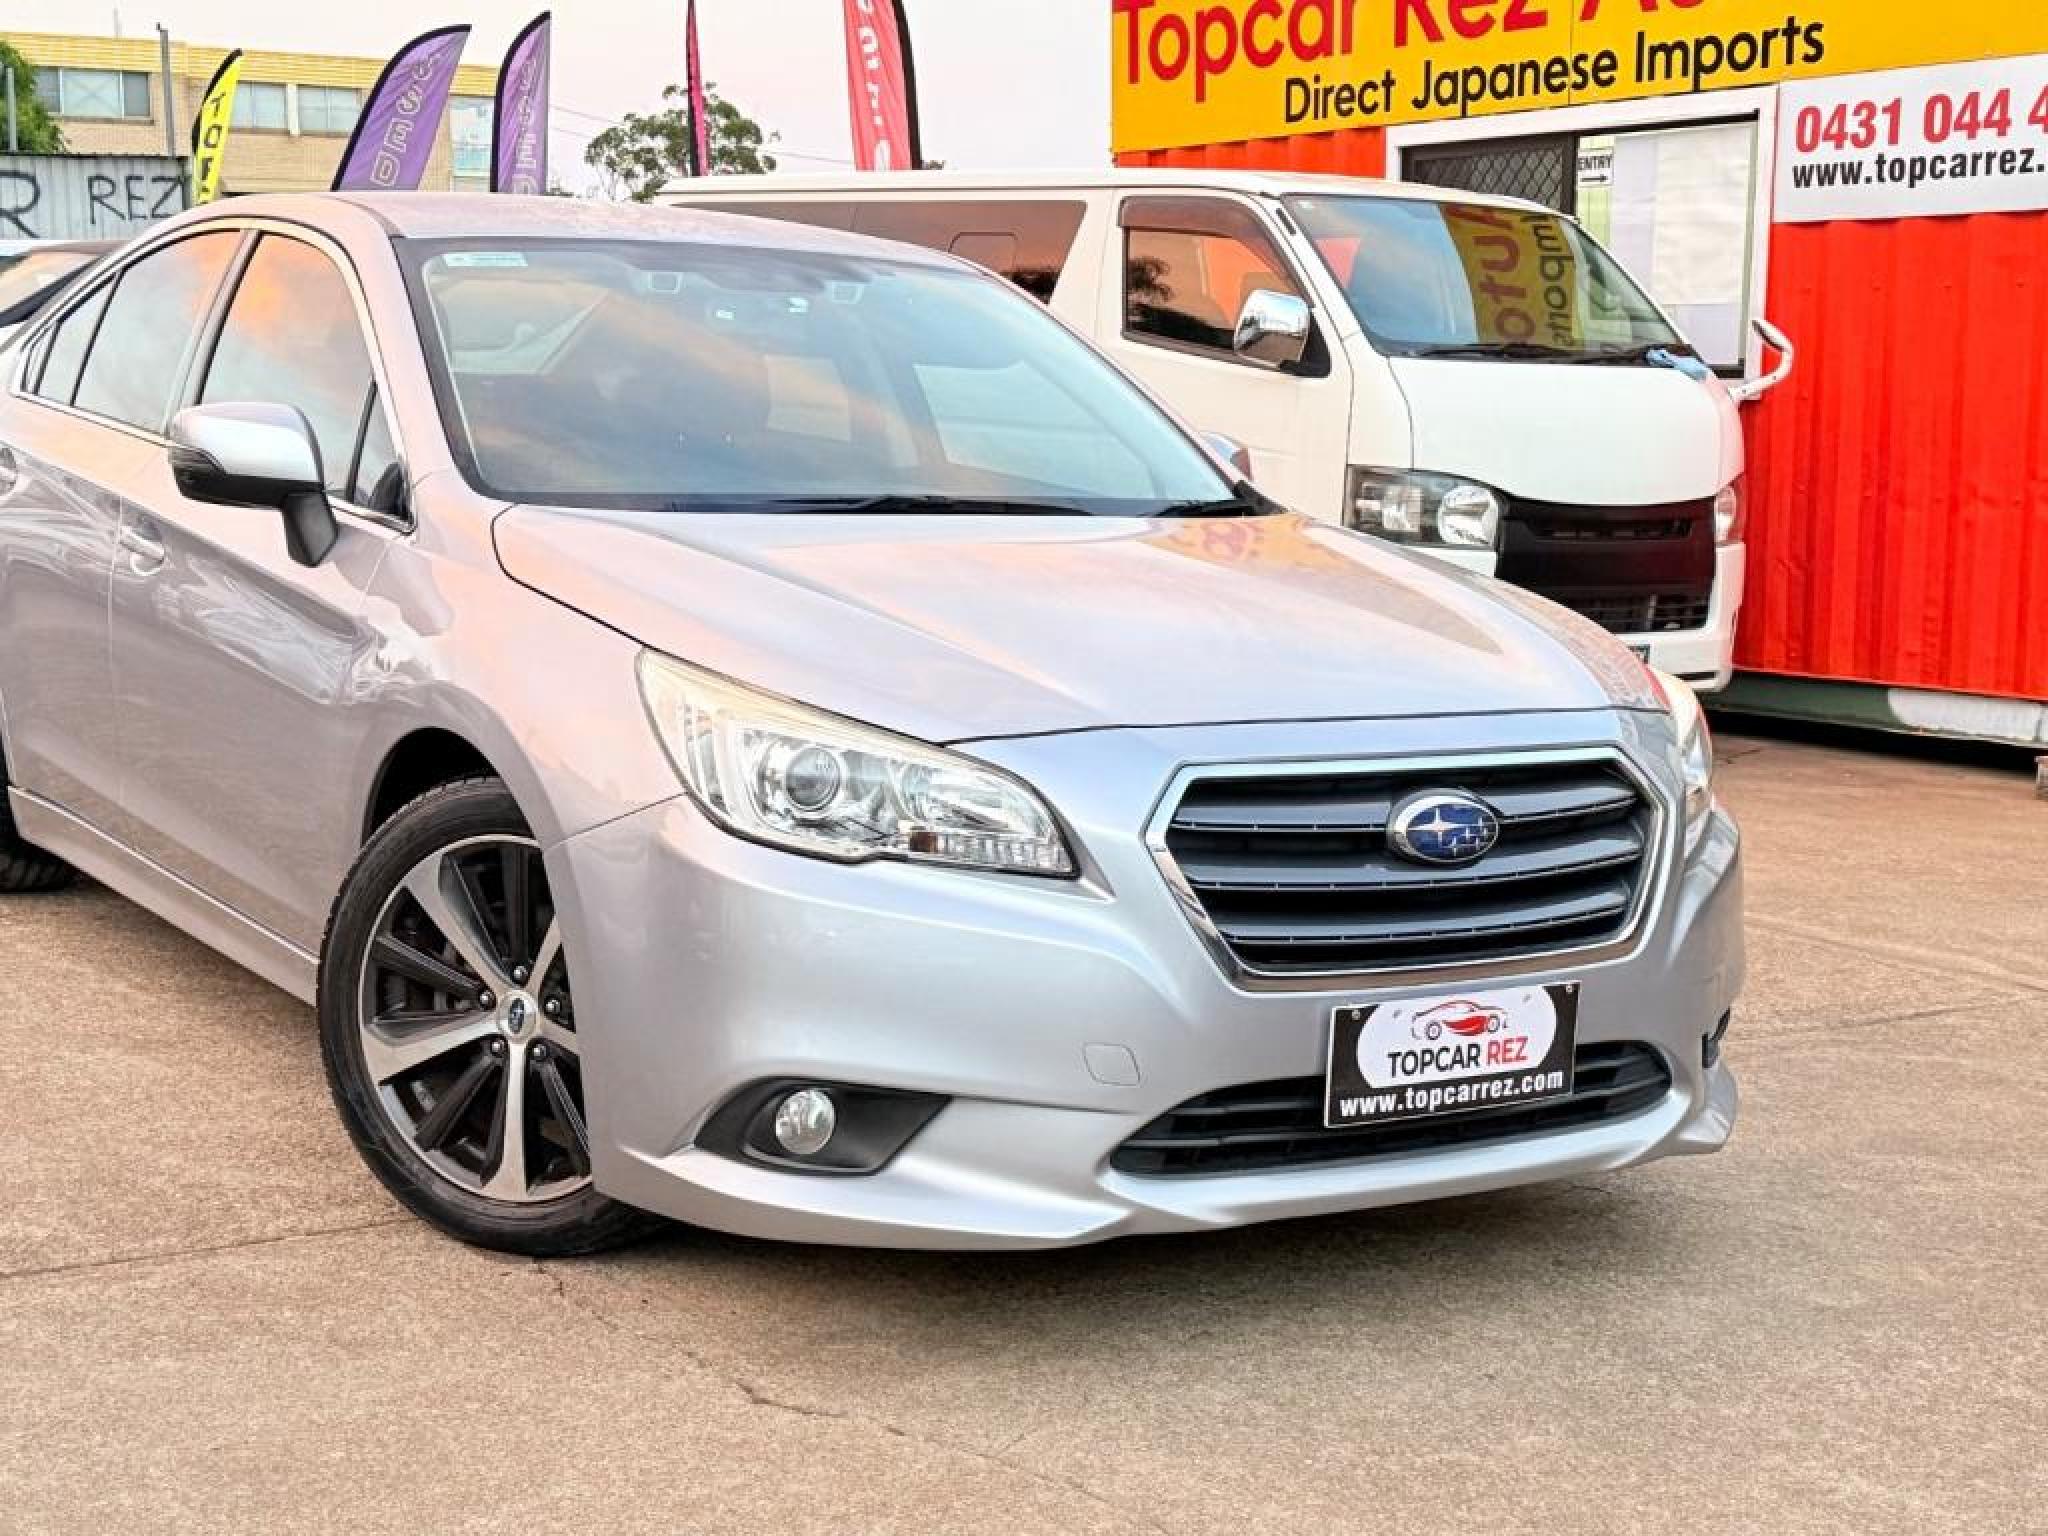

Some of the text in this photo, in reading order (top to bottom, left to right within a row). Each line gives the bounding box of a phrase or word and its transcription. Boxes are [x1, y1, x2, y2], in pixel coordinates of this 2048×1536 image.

[1112, 0, 1352, 103] Topcar
[1285, 15, 1825, 123] Direct Japanese Imports
[1796, 97, 1902, 153] 0431
[1923, 87, 2012, 143] 044
[1577, 155, 1612, 171] ENTRY
[87, 174, 184, 225] REZ
[1387, 1036, 1529, 1079] TOPCAR REZ
[1340, 1070, 1564, 1117] www.topcarrez.com
